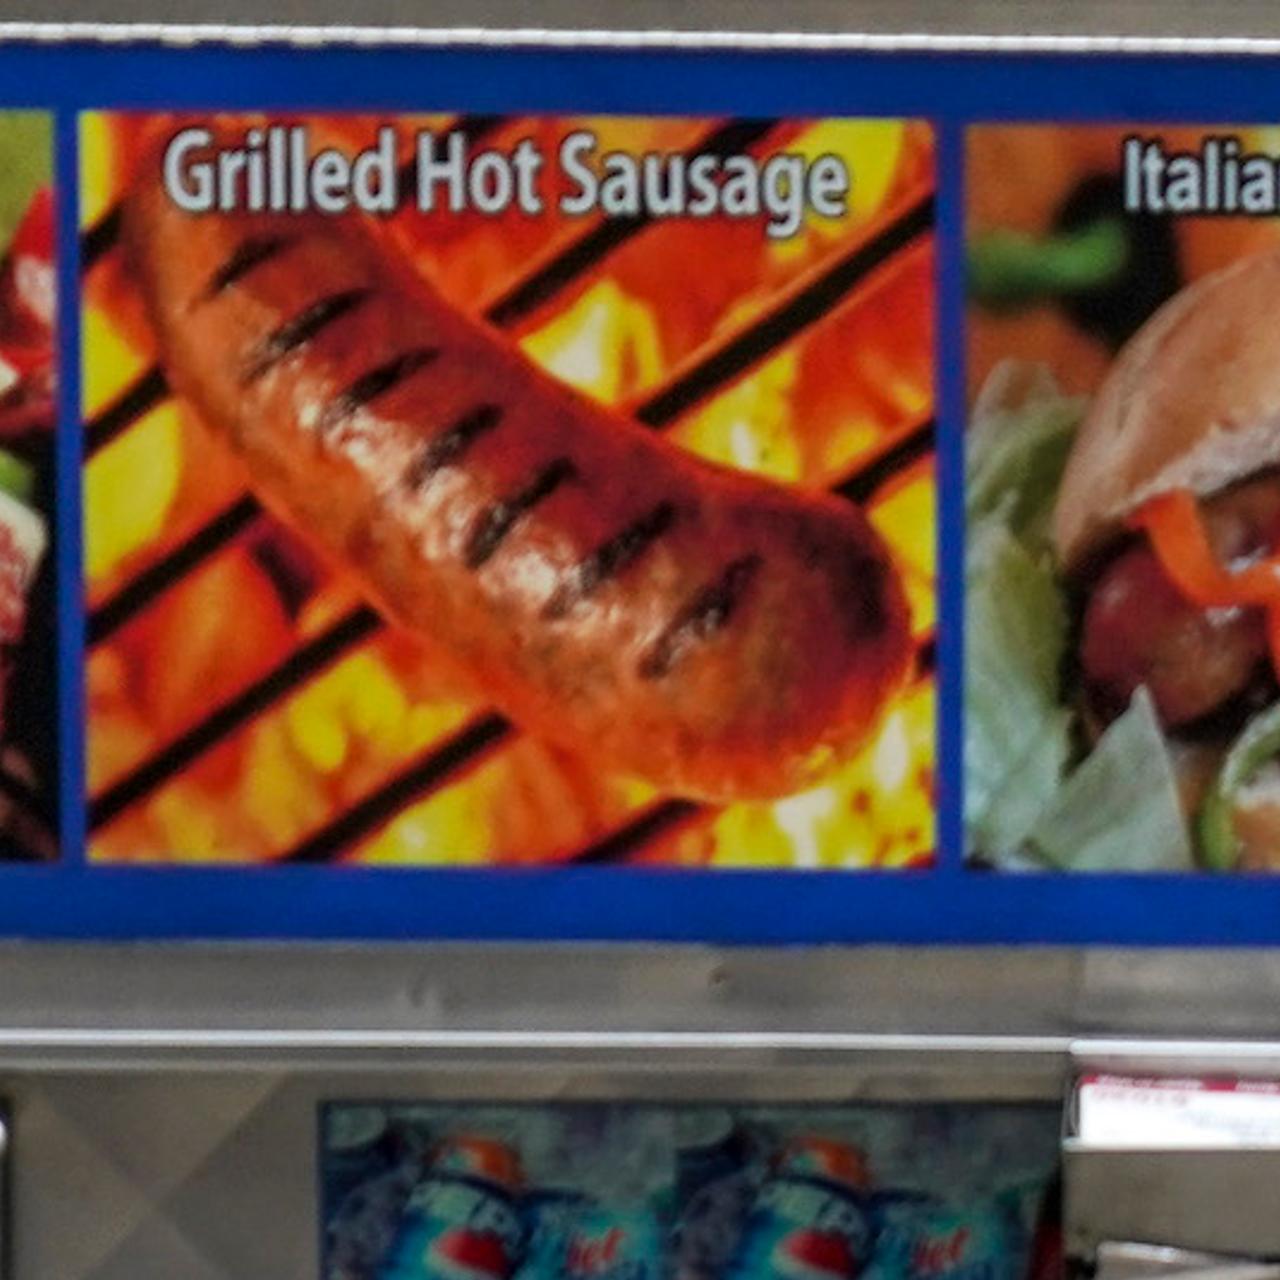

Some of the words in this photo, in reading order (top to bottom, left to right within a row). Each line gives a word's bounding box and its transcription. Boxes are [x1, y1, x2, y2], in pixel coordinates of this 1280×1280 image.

[163, 126, 396, 213] Grilled
[417, 131, 542, 213] Hot
[558, 132, 848, 239] Sausage
